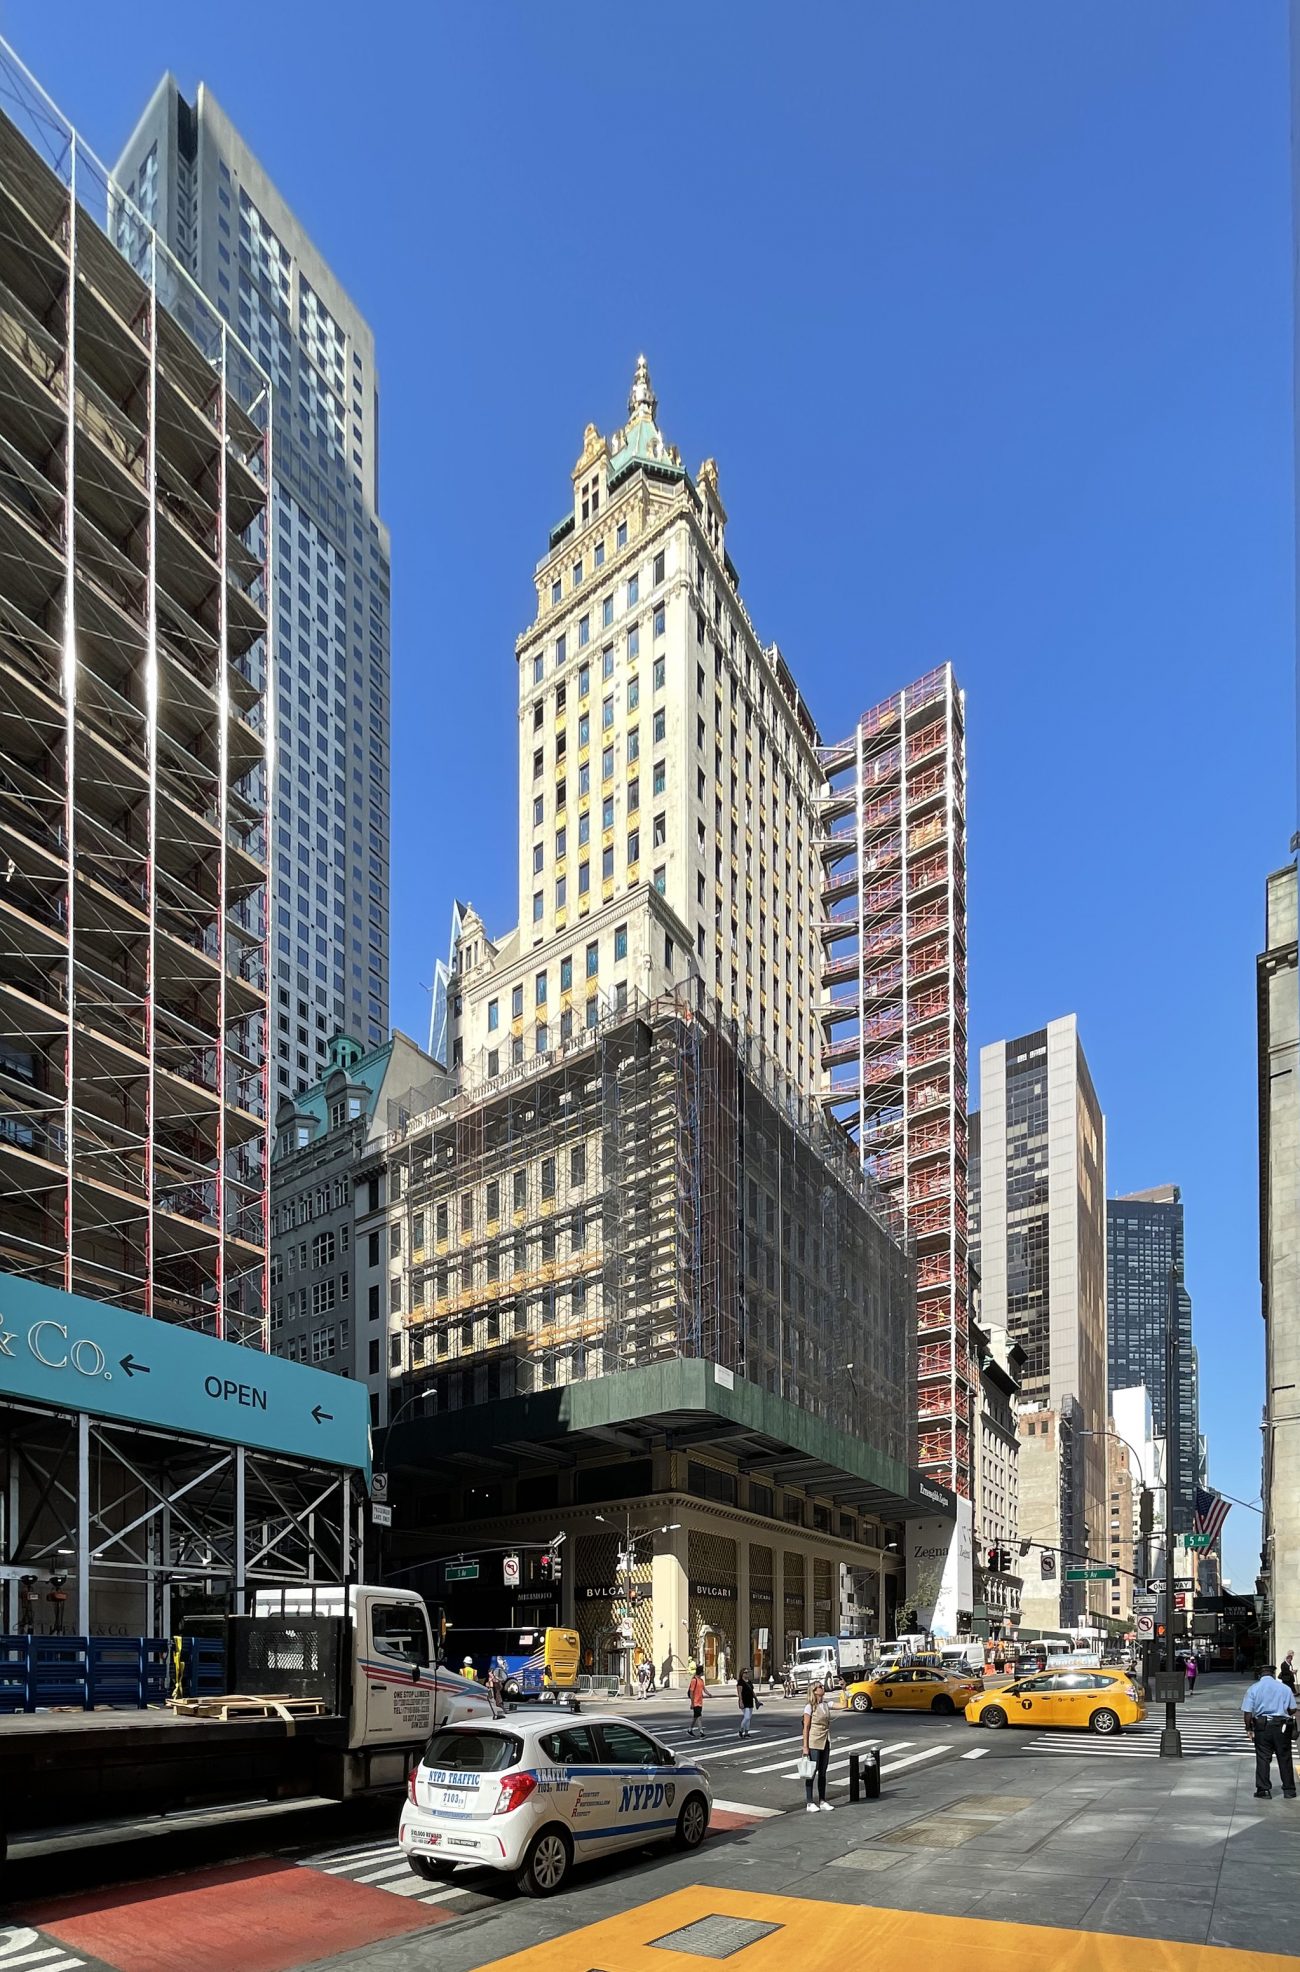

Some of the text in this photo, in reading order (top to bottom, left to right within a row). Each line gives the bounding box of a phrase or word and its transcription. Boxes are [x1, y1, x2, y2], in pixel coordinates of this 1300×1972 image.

[204, 1375, 267, 1410] OPEN
[1189, 1536, 1195, 1546] 5
[914, 1545, 949, 1560] Zegna
[696, 1585, 731, 1597] BVLGARI
[429, 1771, 480, 1785] NYPD TRAFFIC
[536, 1769, 568, 1782] TRAFFIC
[443, 1793, 459, 1803] 7103
[618, 1783, 664, 1812] NYPD
